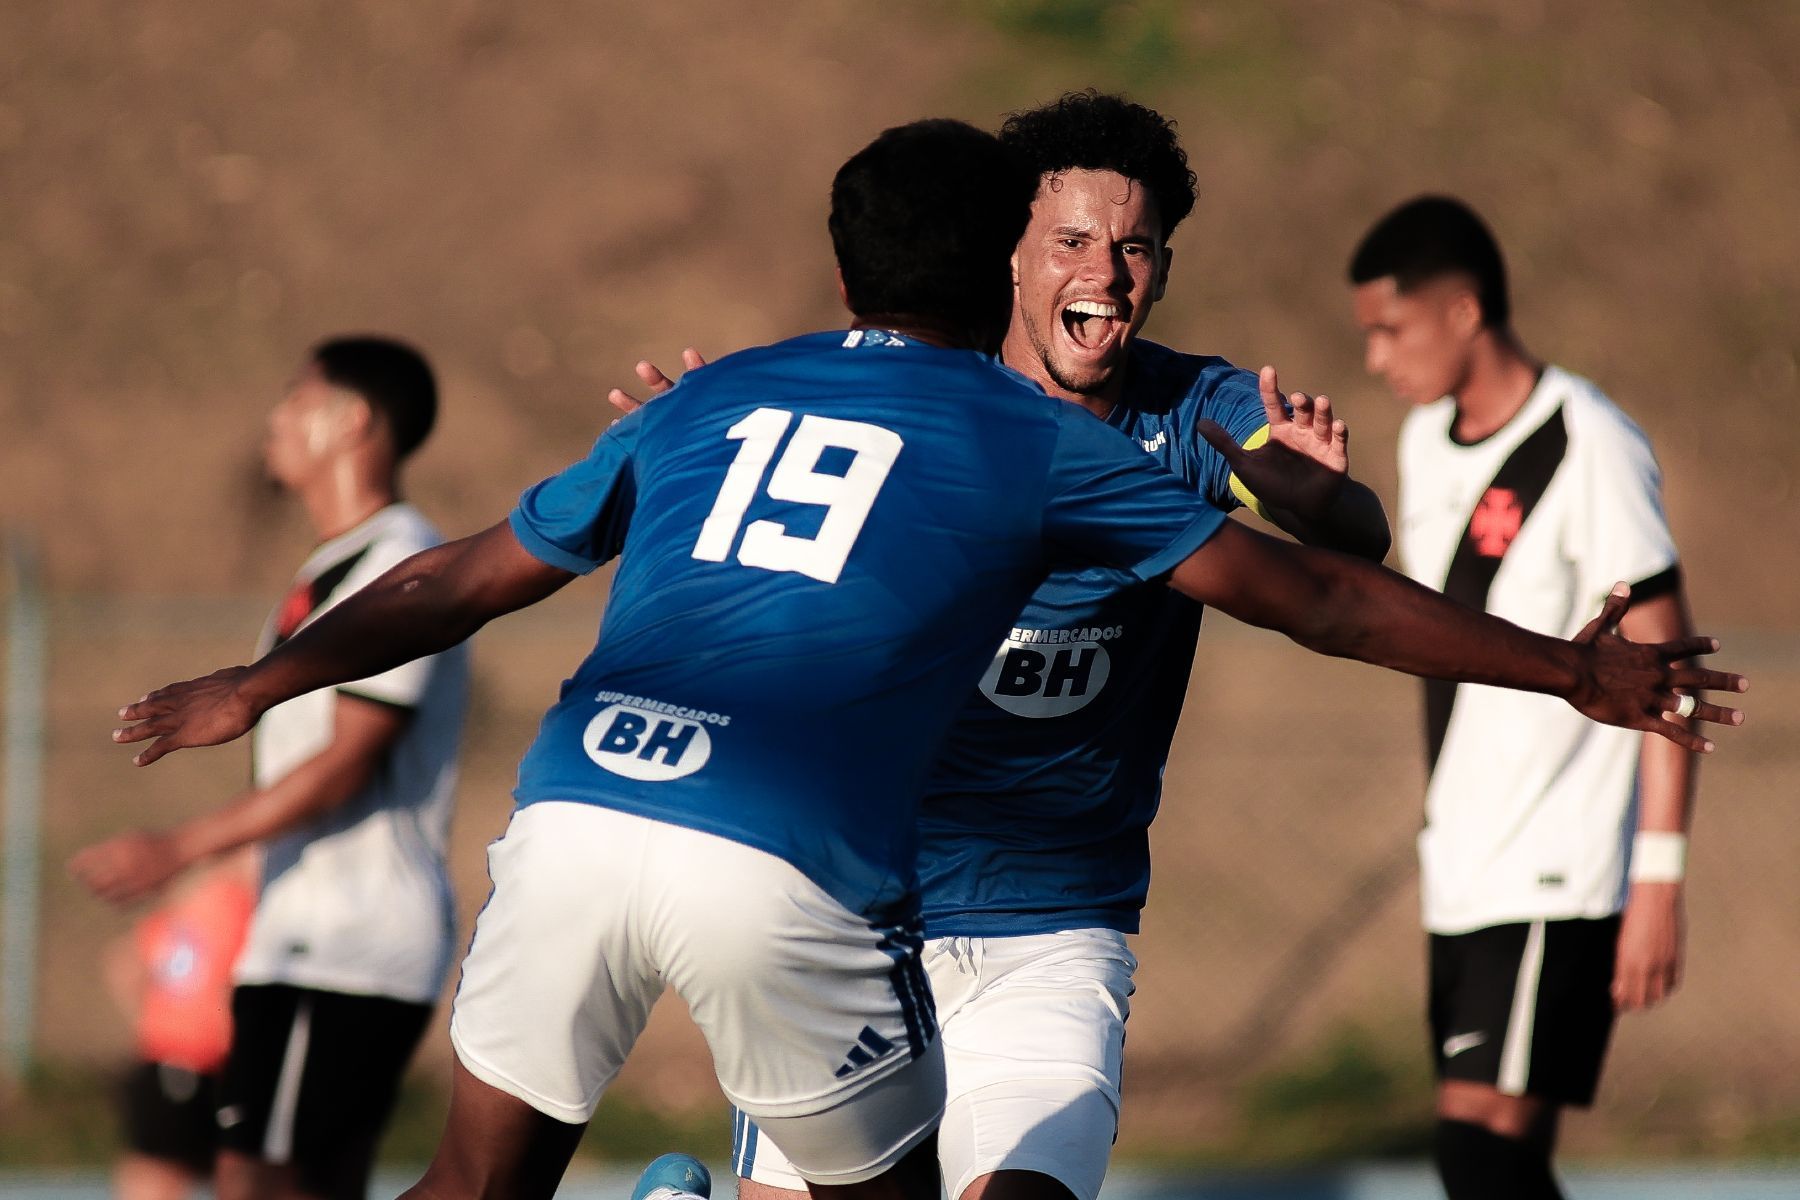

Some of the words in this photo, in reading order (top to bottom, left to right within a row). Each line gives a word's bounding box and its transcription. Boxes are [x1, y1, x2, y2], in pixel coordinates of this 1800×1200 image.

[691, 407, 904, 584] 19
[1008, 625, 1123, 644] ERMERCADOS
[994, 646, 1099, 698] BH
[594, 690, 731, 727] SUPERMERCADOS
[596, 711, 700, 767] BH
